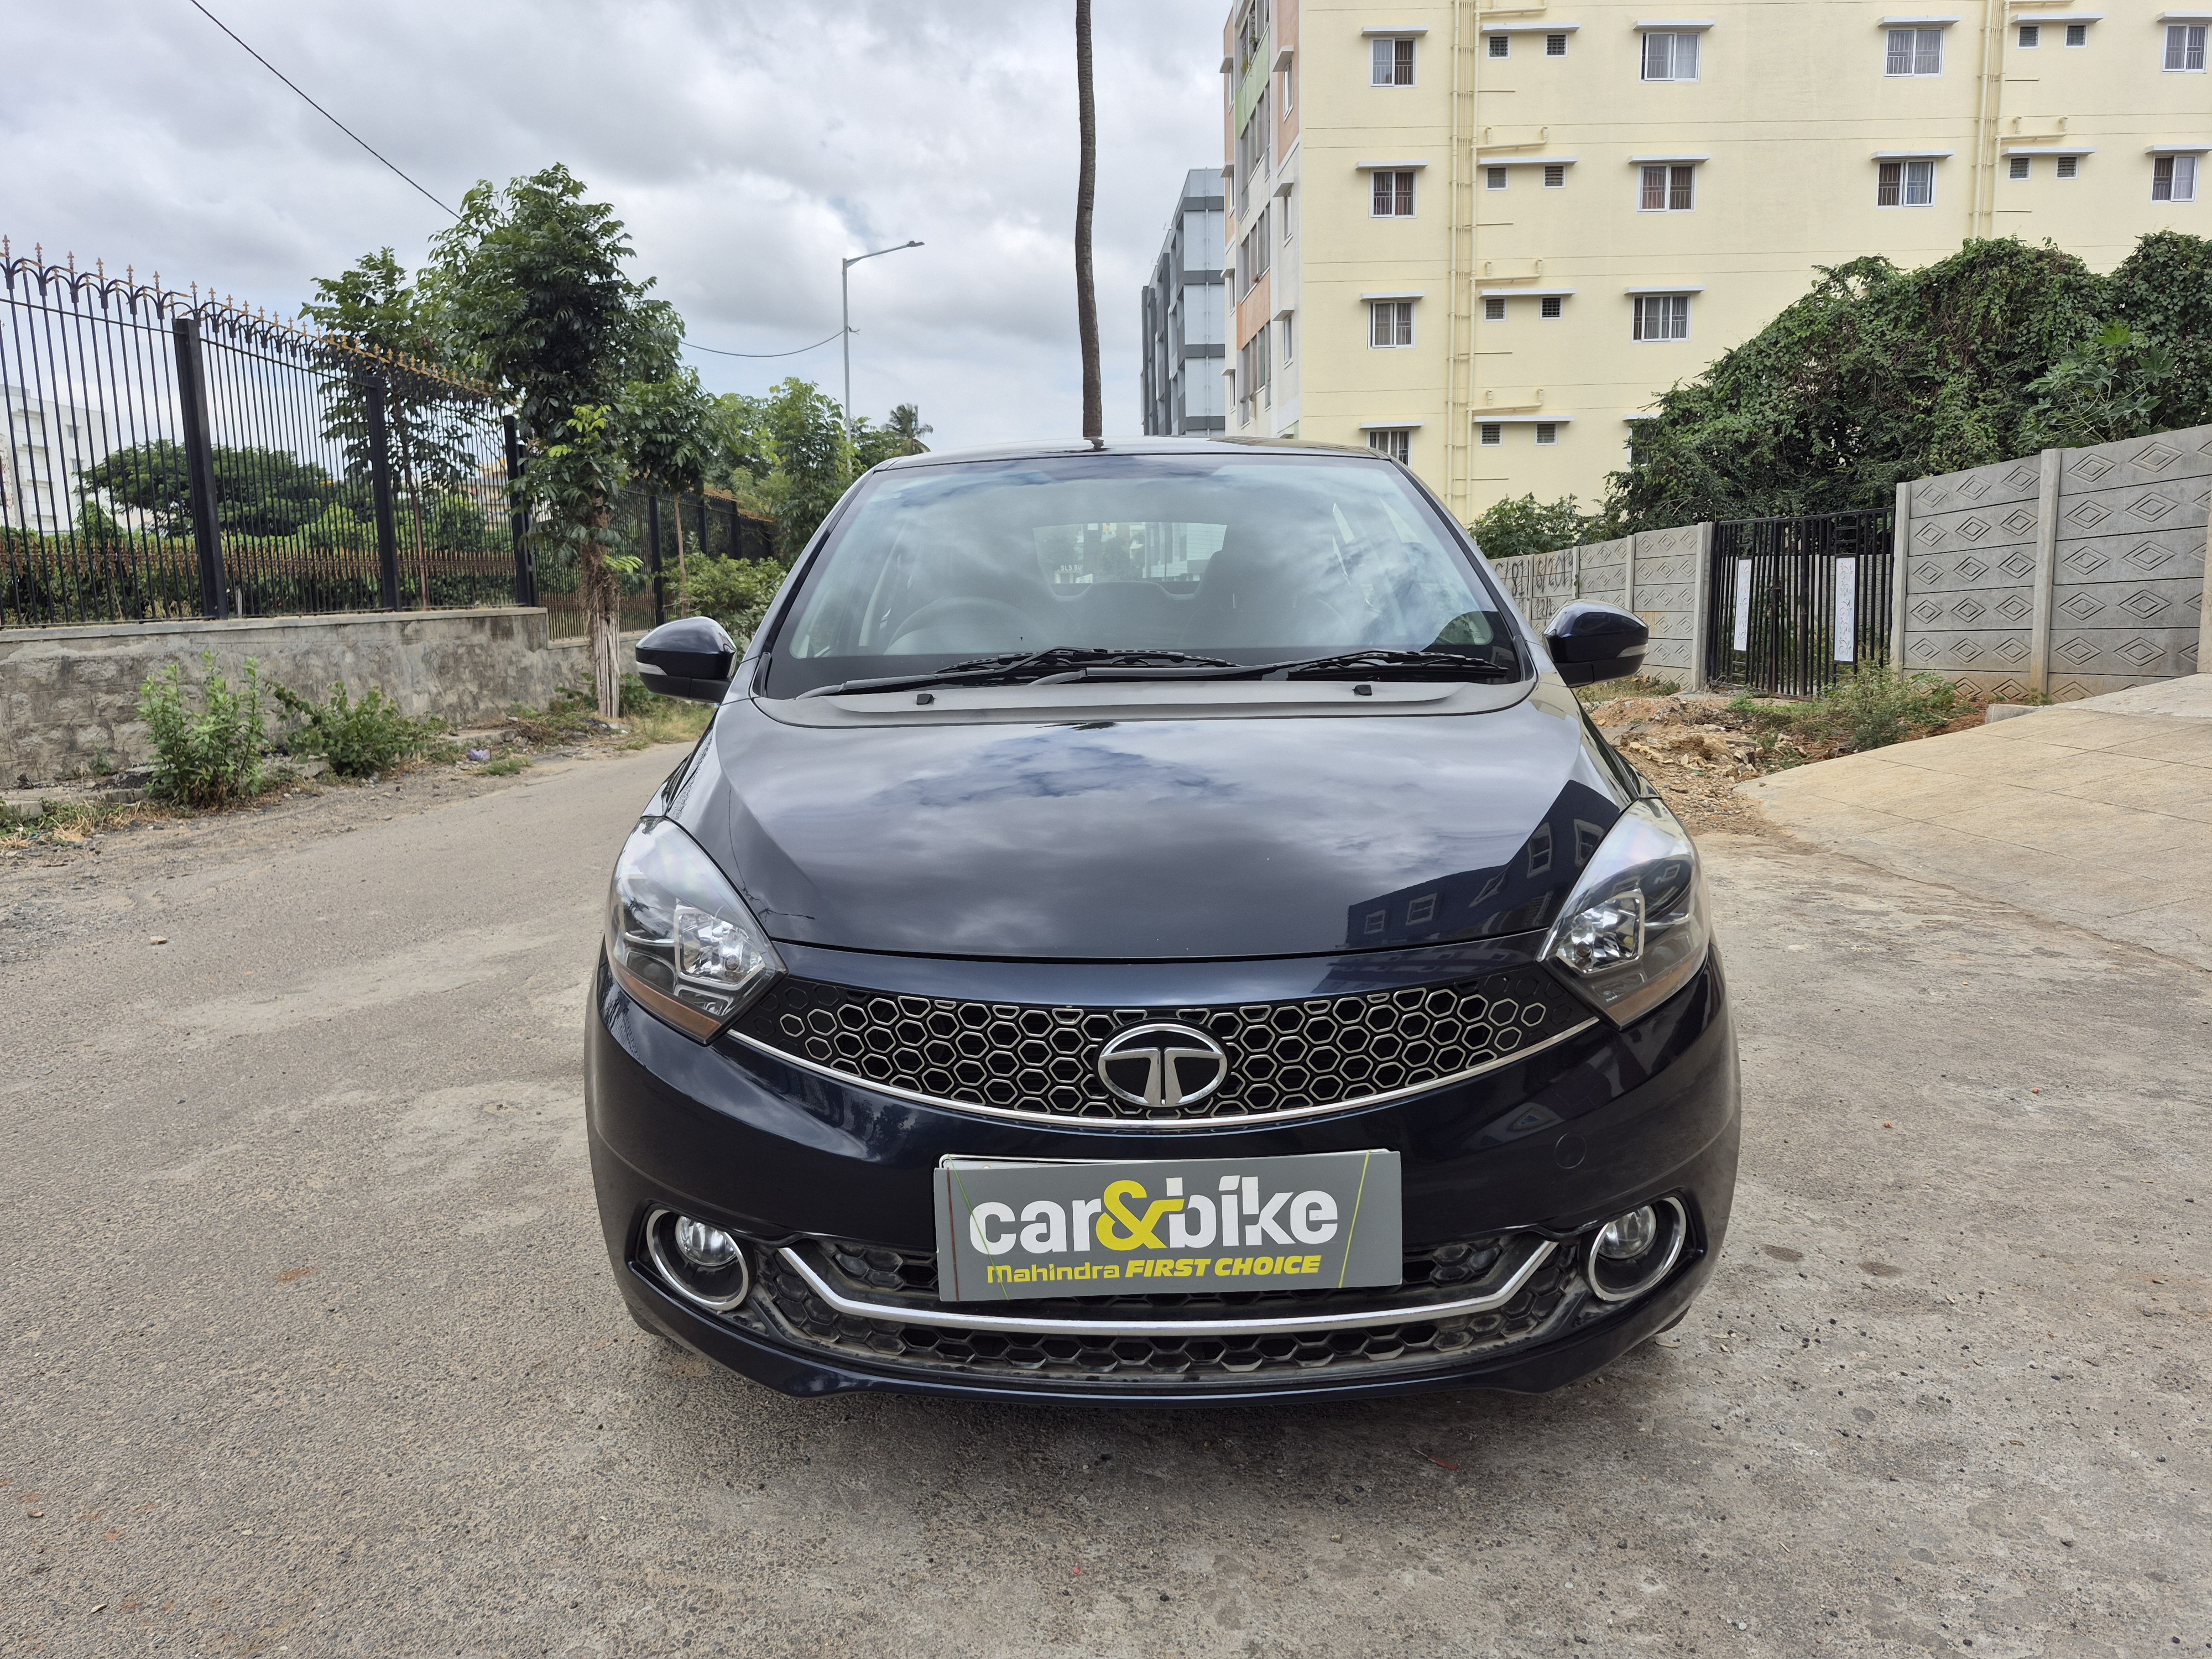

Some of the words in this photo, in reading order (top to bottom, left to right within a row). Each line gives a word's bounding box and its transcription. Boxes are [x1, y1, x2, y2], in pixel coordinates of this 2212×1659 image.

[969, 1175, 1338, 1255] car&bike
[987, 1262, 1120, 1283] Mahindra
[1125, 1258, 1212, 1277] FIRST
[1215, 1255, 1322, 1276] CHOICE
